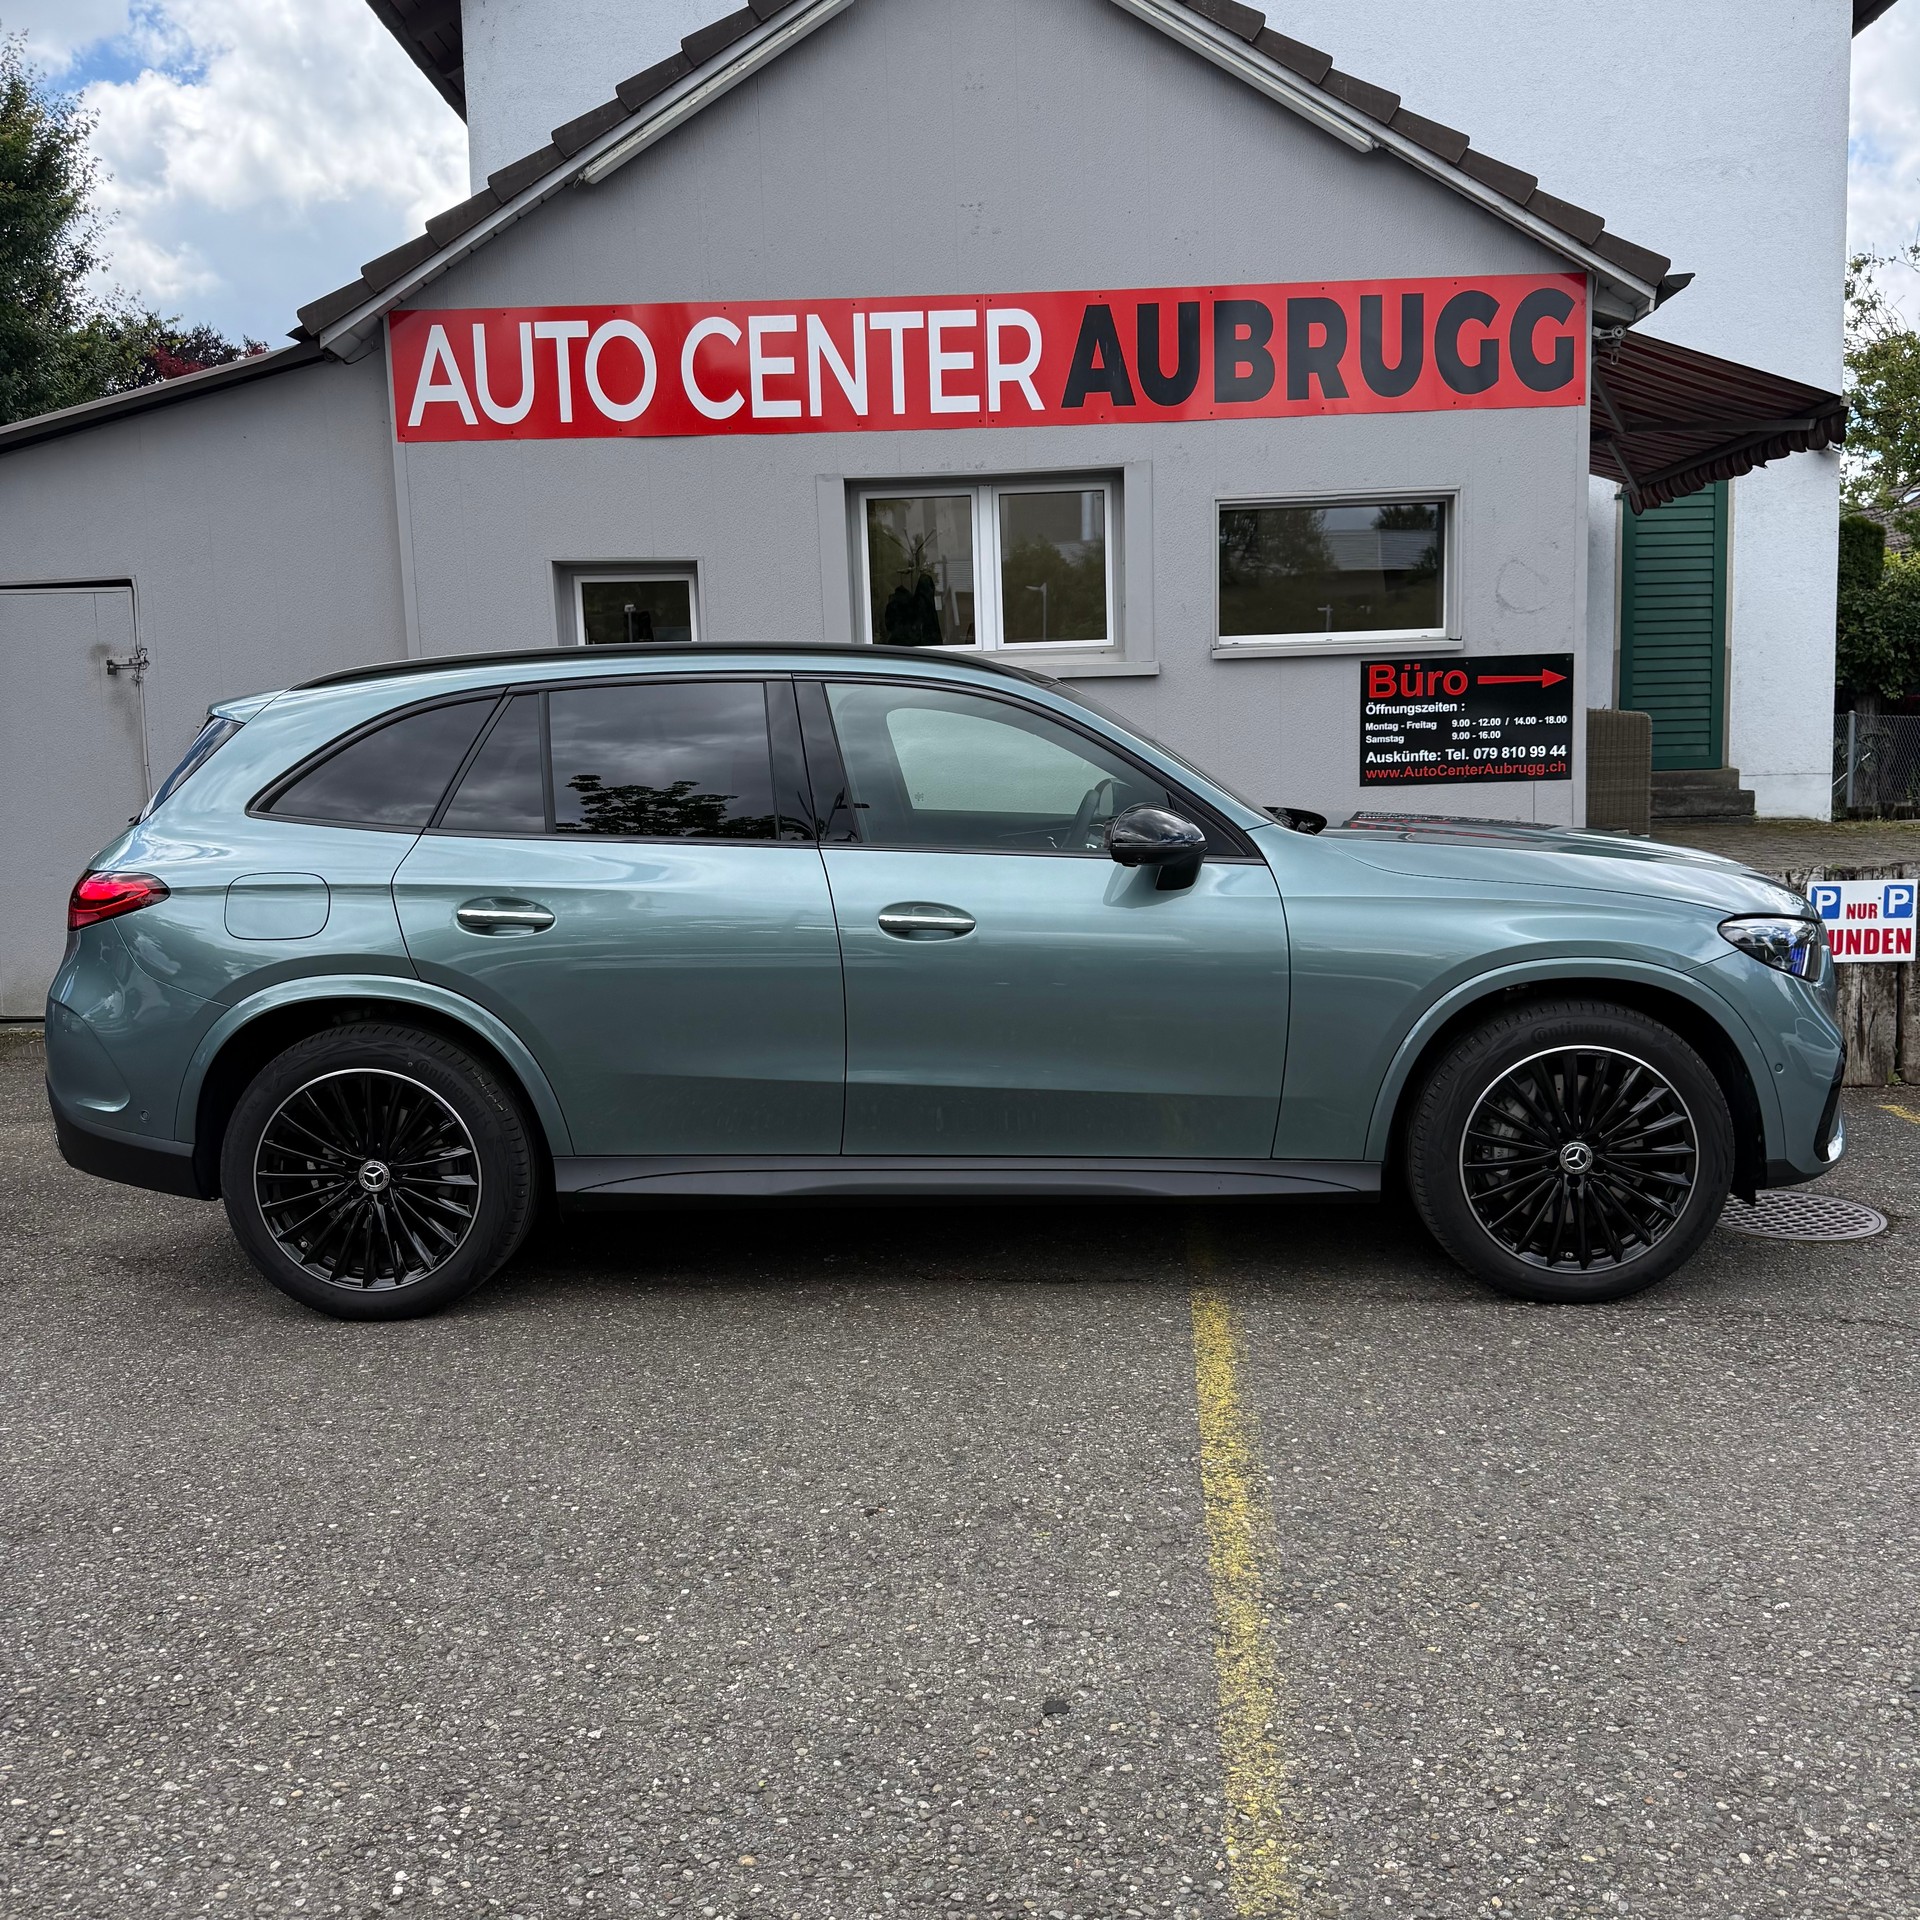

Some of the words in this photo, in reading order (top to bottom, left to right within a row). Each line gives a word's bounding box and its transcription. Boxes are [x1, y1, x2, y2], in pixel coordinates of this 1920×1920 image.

[408, 319, 657, 427] AUTO
[681, 308, 1045, 420] CENTER
[1061, 287, 1576, 409] AUBRUGG
[1369, 664, 1468, 698] Büro
[1366, 703, 1457, 715] Öffnungszeiten
[1366, 722, 1398, 731] Montag
[1407, 721, 1437, 730] Freitag
[1478, 718, 1500, 726] 12.00
[1514, 717, 1536, 725] 14.00
[1545, 716, 1567, 724] 18.00
[1366, 736, 1404, 744] Samstag
[1452, 732, 1469, 740] 9.00
[1478, 731, 1500, 739] 16.00
[1366, 750, 1441, 763] Auskünfte:
[1446, 749, 1469, 761] Tel.
[1473, 748, 1497, 759] 079
[1502, 747, 1525, 758] 810
[1530, 746, 1546, 757] 99
[1550, 745, 1566, 756] 44
[1366, 761, 1566, 778] www.AutoCenterAubrugg.ch
[1846, 903, 1877, 919] NUR
[1889, 889, 1909, 913] P
[1828, 928, 1911, 955] UNDEN
